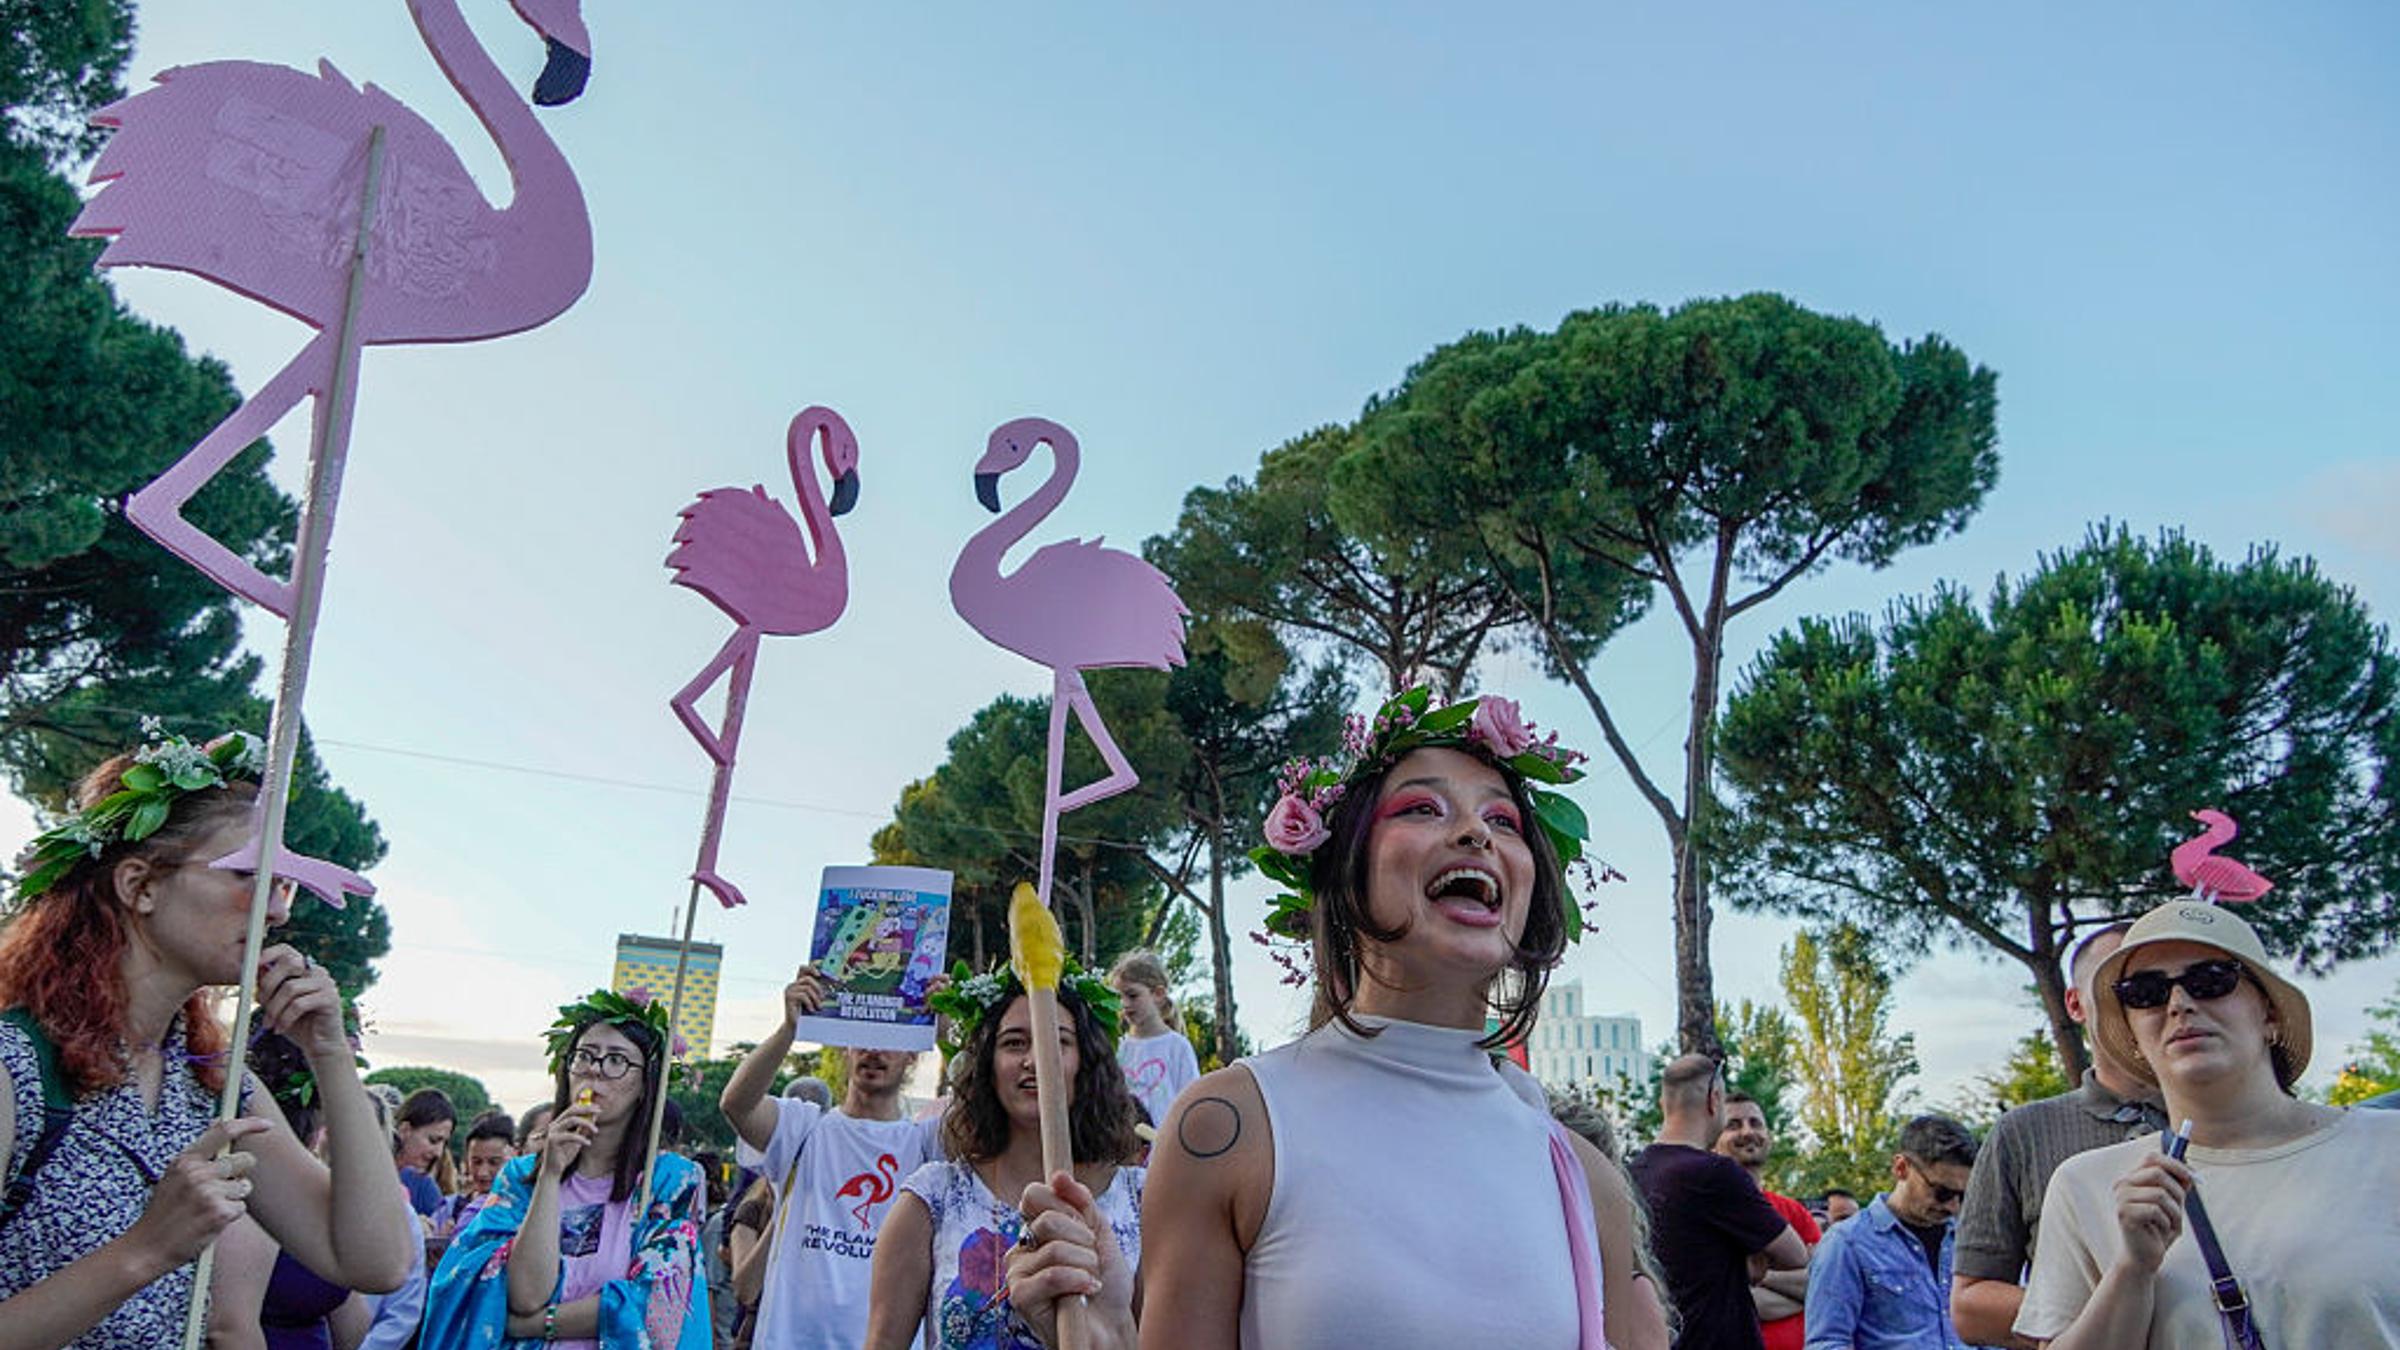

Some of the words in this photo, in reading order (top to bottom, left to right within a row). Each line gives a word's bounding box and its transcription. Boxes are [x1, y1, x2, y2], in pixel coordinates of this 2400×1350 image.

[836, 992, 855, 1006] THE
[840, 1005, 897, 1022] REVOLUTION
[834, 1230, 877, 1246] FLAM
[801, 1236, 873, 1259] REVOLU
